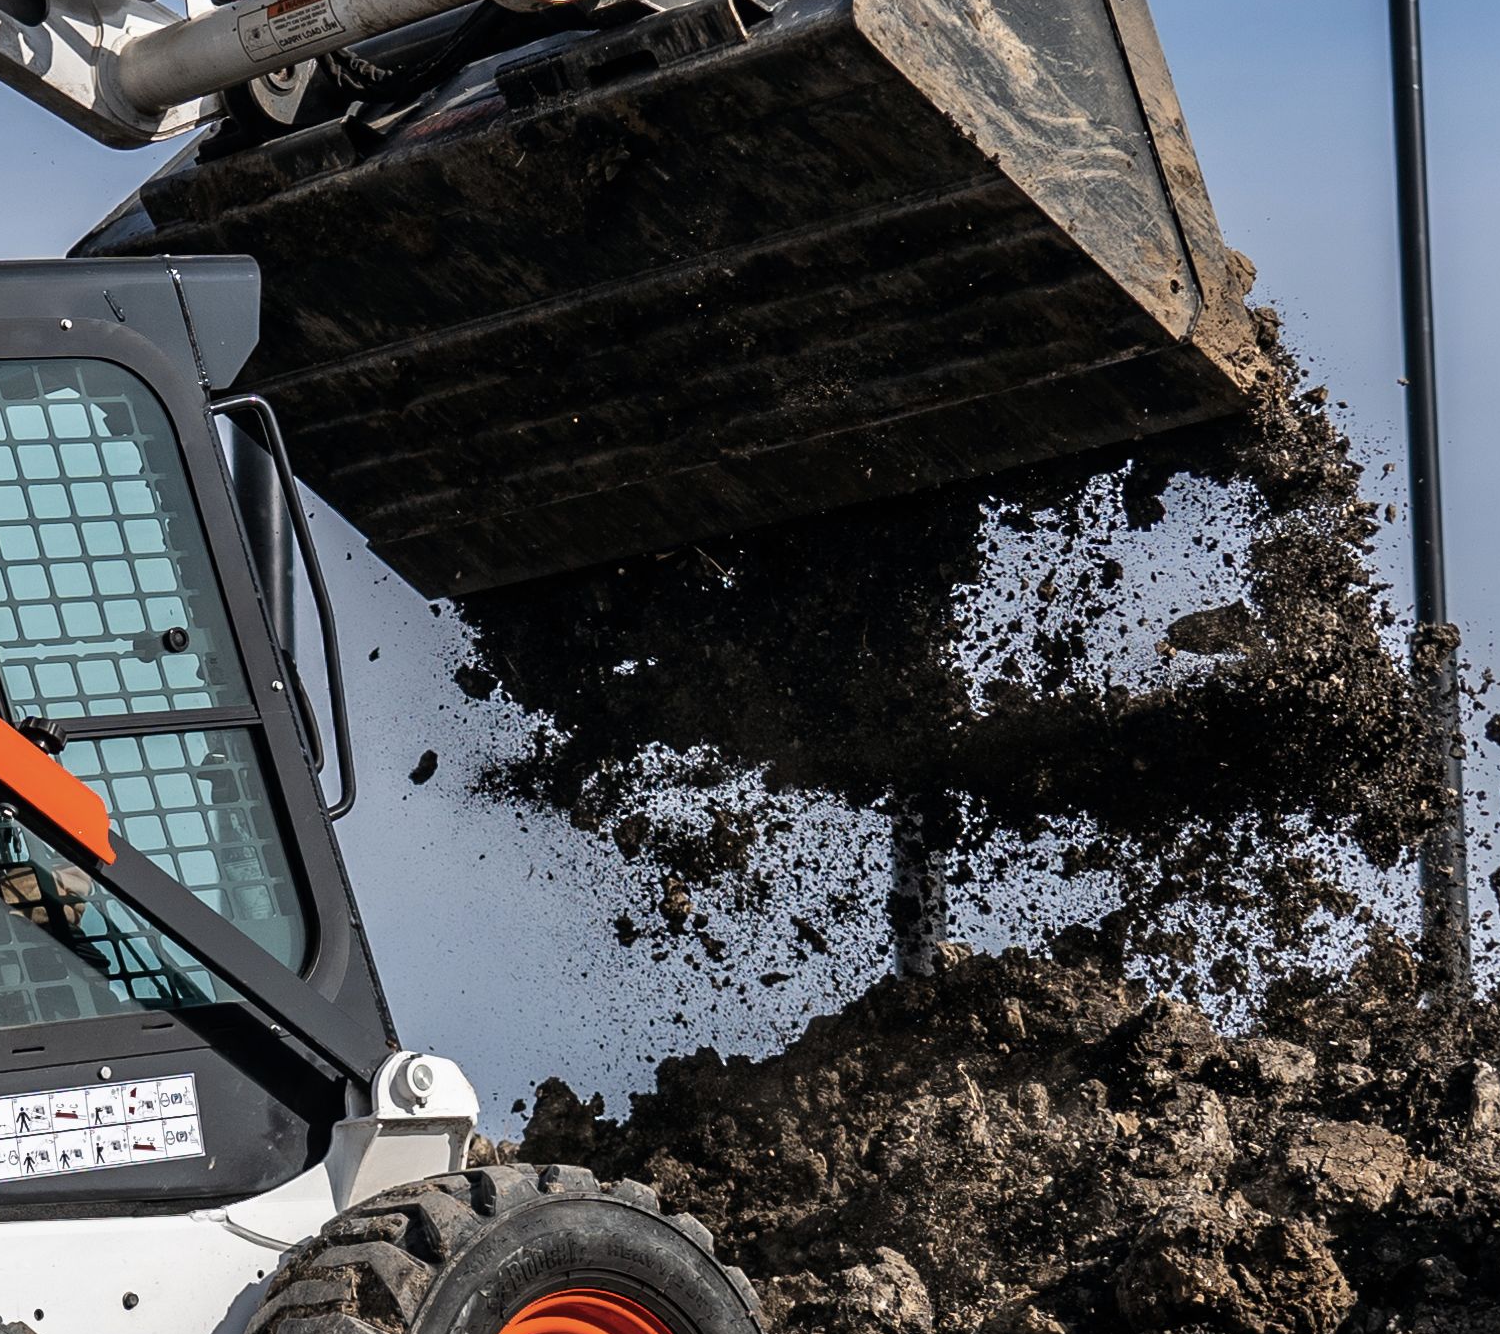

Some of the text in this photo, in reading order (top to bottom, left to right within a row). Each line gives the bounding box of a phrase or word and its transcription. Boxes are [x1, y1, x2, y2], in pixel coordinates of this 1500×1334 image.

[279, 33, 303, 47] CARRY
[302, 27, 322, 39] LOAD
[321, 20, 338, 33] LOW
